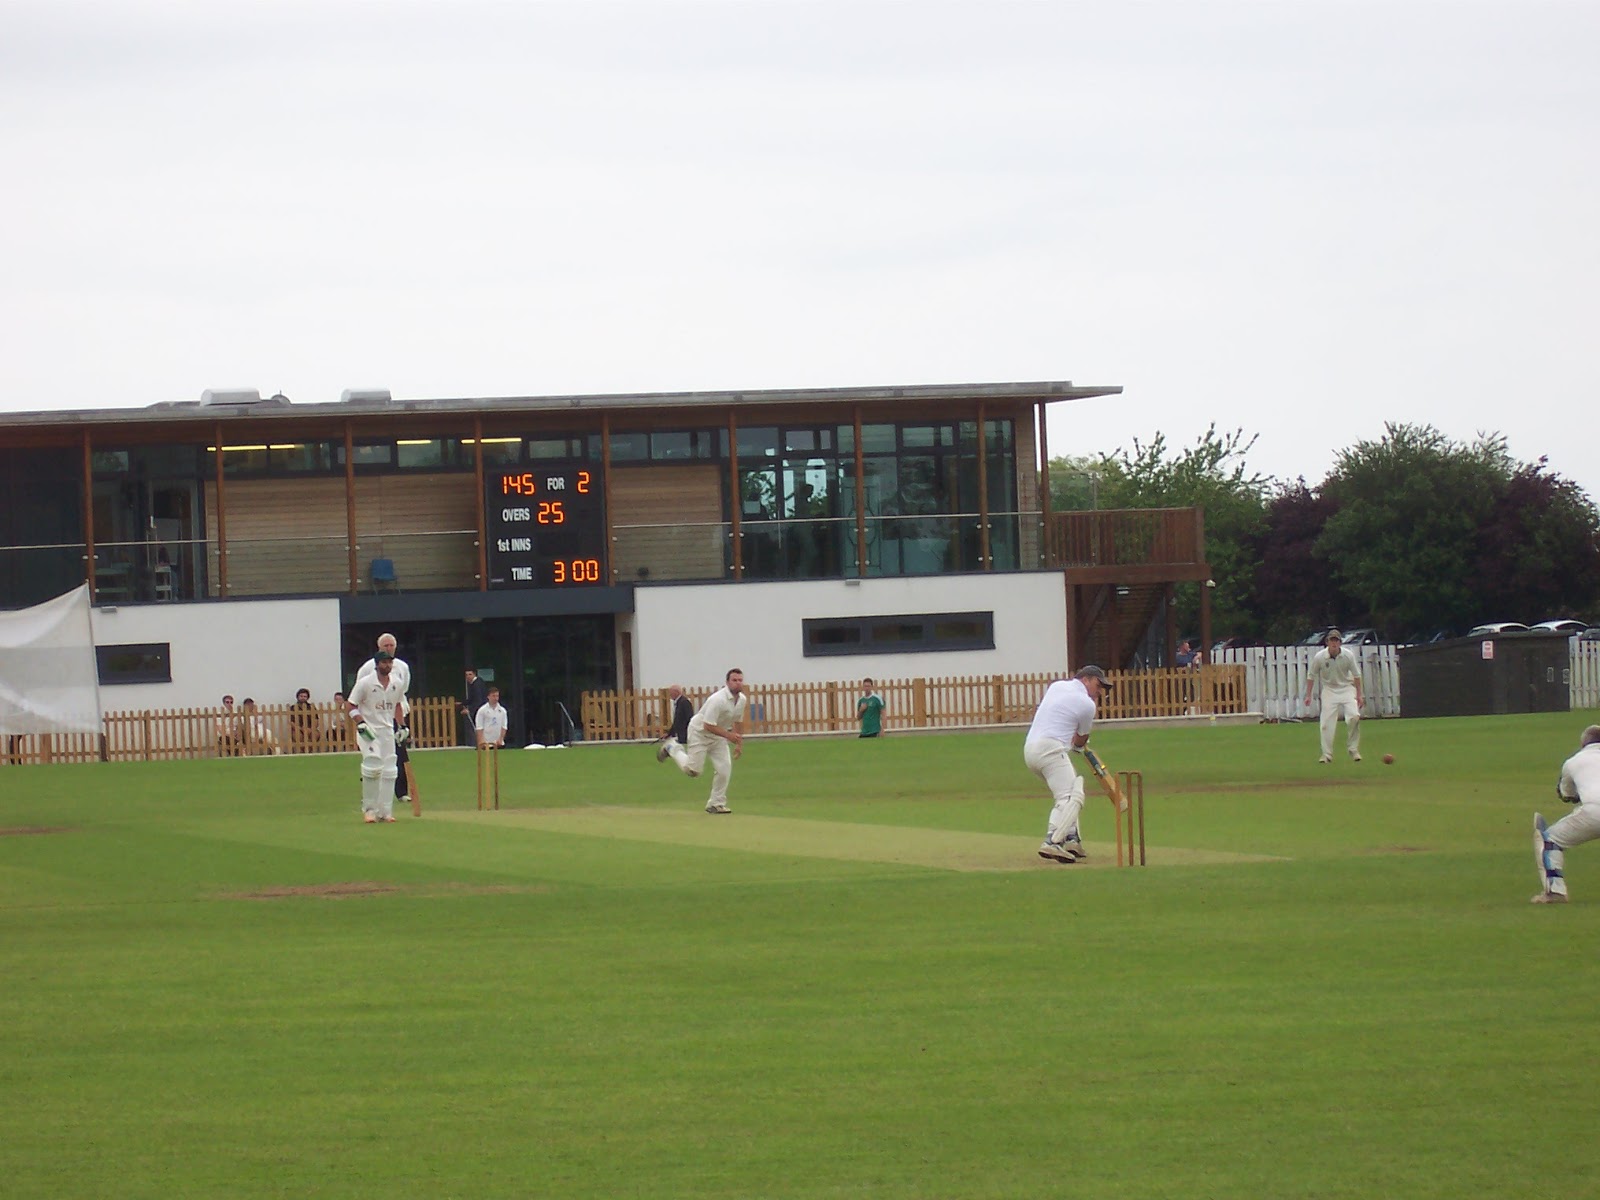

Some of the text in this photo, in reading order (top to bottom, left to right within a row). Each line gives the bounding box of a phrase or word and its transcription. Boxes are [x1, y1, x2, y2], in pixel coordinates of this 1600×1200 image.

[502, 471, 590, 495] 145 FOR 2
[502, 502, 564, 524] OVERS 25
[497, 538, 531, 552] 1st INNS
[511, 567, 532, 580] TIME
